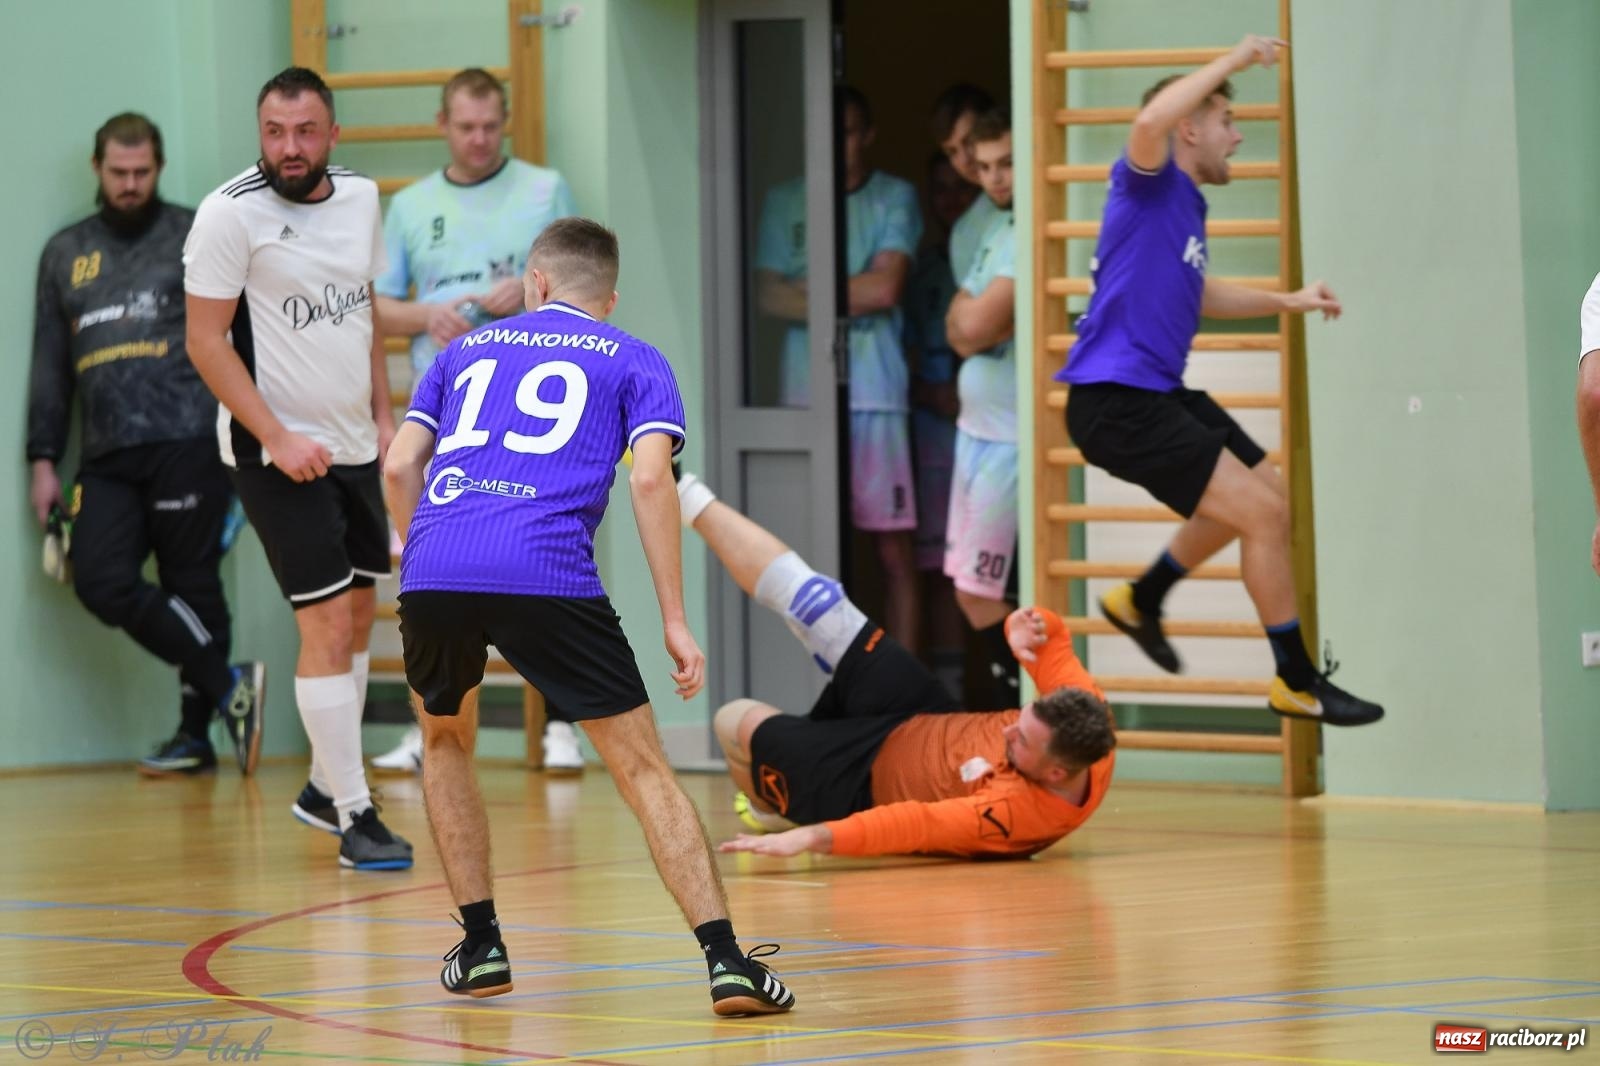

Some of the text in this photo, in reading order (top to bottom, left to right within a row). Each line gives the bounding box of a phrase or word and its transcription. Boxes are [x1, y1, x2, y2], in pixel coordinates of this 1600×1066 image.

[432, 215, 446, 242] 9
[461, 328, 620, 358] NOWAKOWSKI
[436, 358, 589, 456] 19
[428, 466, 537, 505] GEO-METR
[975, 551, 1005, 580] 20
